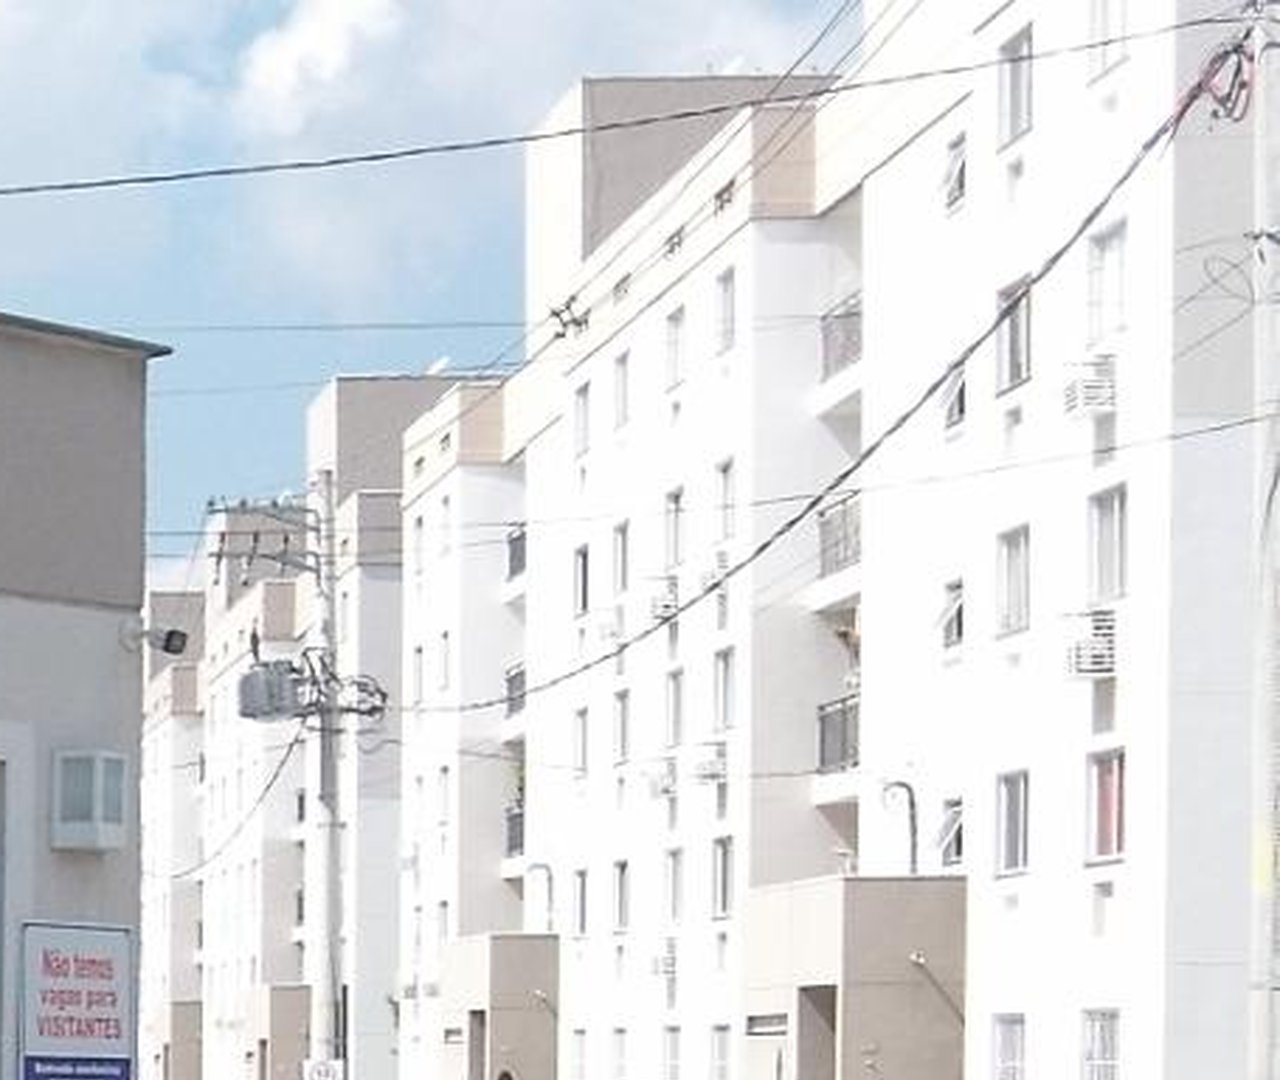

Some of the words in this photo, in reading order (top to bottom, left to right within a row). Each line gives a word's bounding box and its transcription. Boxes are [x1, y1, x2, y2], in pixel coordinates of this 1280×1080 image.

[42, 946, 71, 977] Não
[73, 953, 114, 980] temos
[39, 989, 82, 1011] vagas
[86, 989, 118, 1011] para
[37, 1014, 122, 1039] VISITANTES
